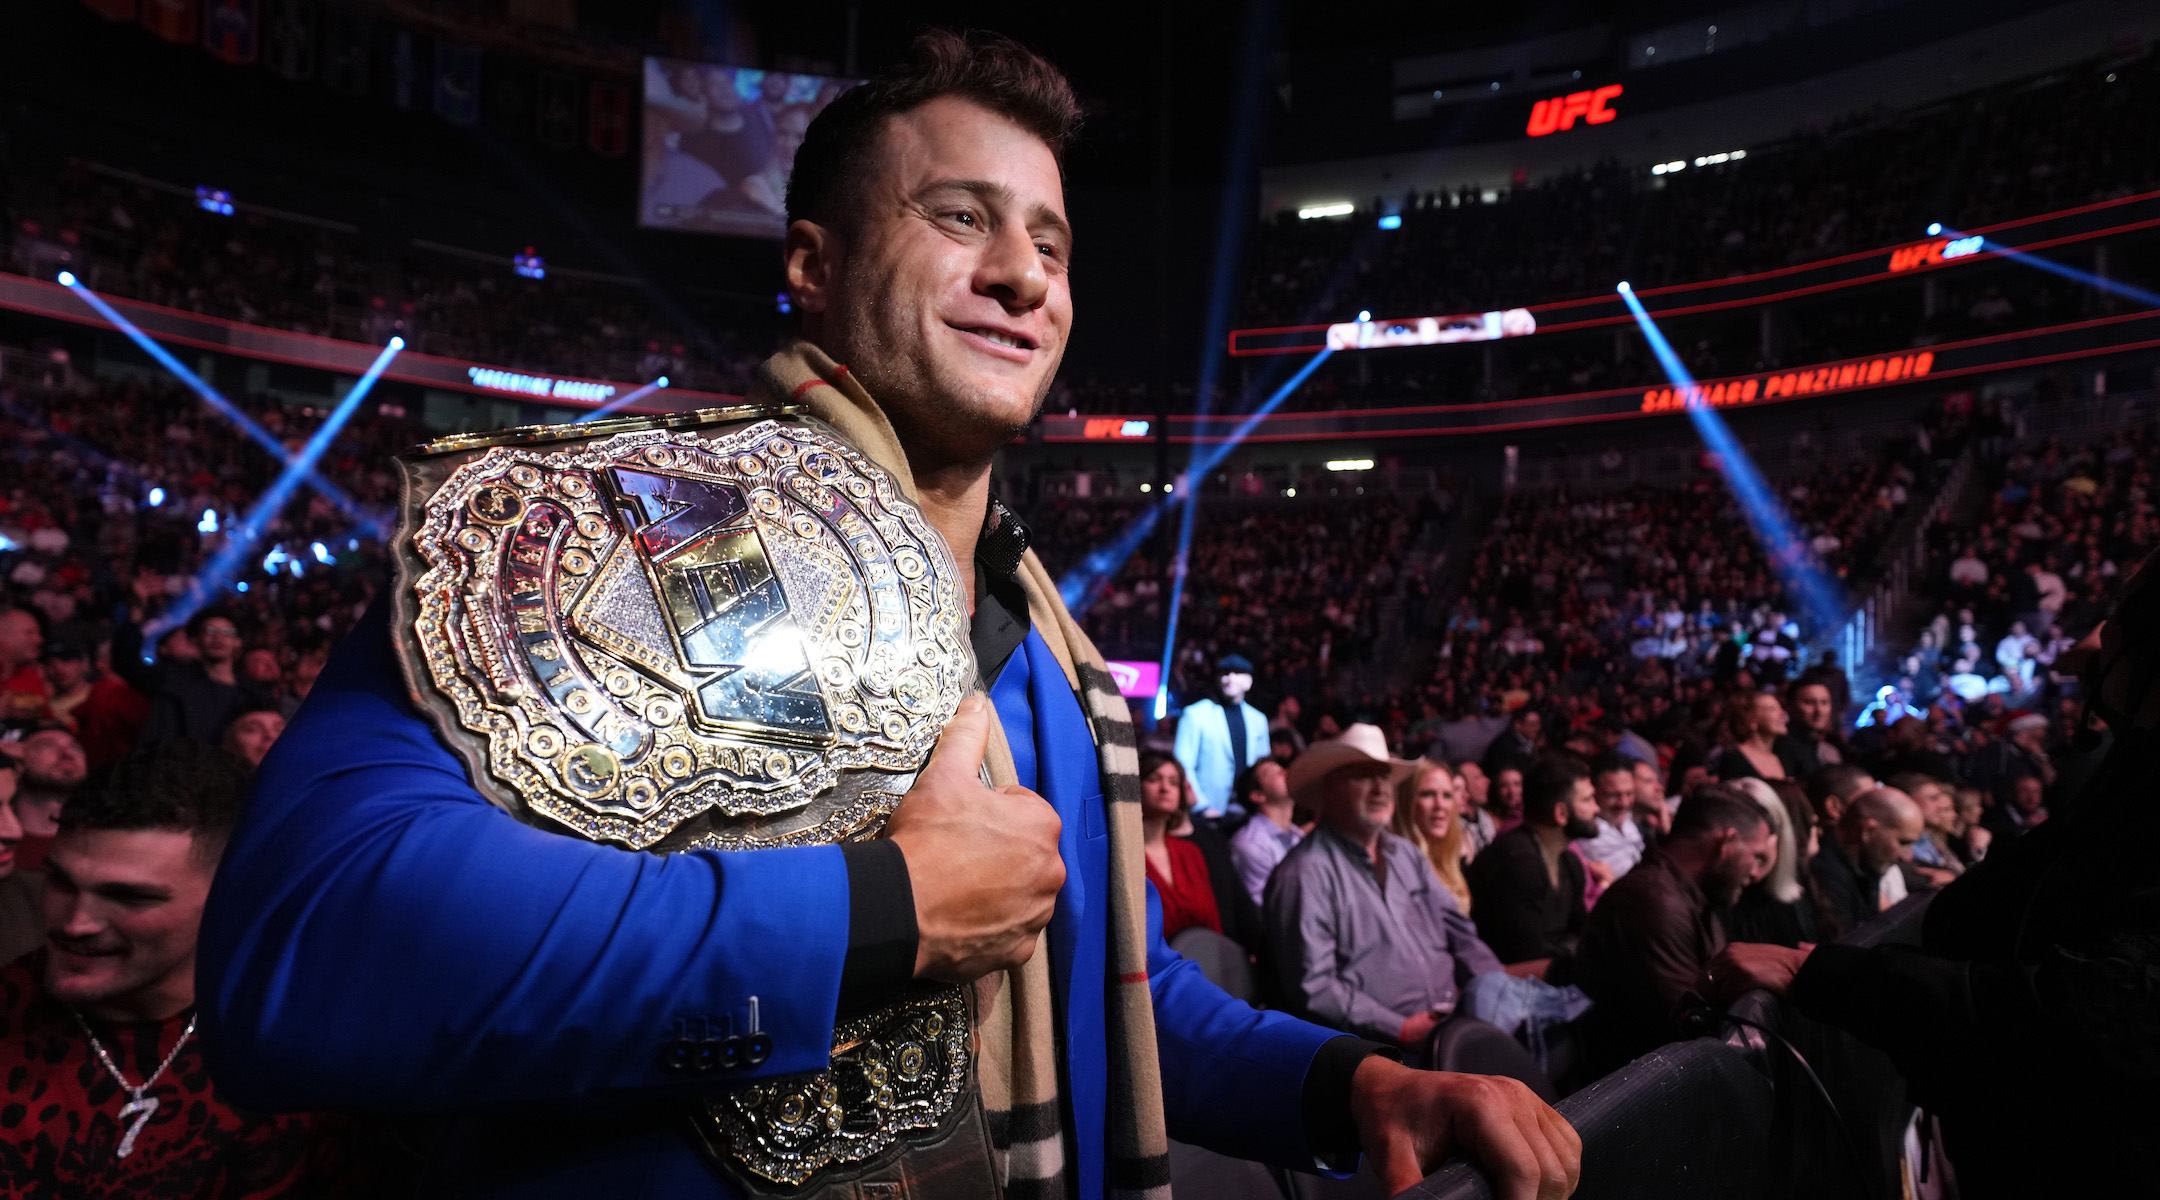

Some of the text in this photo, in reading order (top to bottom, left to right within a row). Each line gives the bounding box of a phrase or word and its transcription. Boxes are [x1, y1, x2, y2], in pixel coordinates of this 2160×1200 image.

[1526, 83, 1624, 137] UFC
[1641, 379, 1759, 412] SANTIAGO
[606, 463, 838, 740] AEW
[836, 510, 900, 634] WORLD
[469, 597, 504, 681] FRIEDMAN
[512, 515, 624, 743] CHAMPION
[117, 1097, 160, 1159] 7
